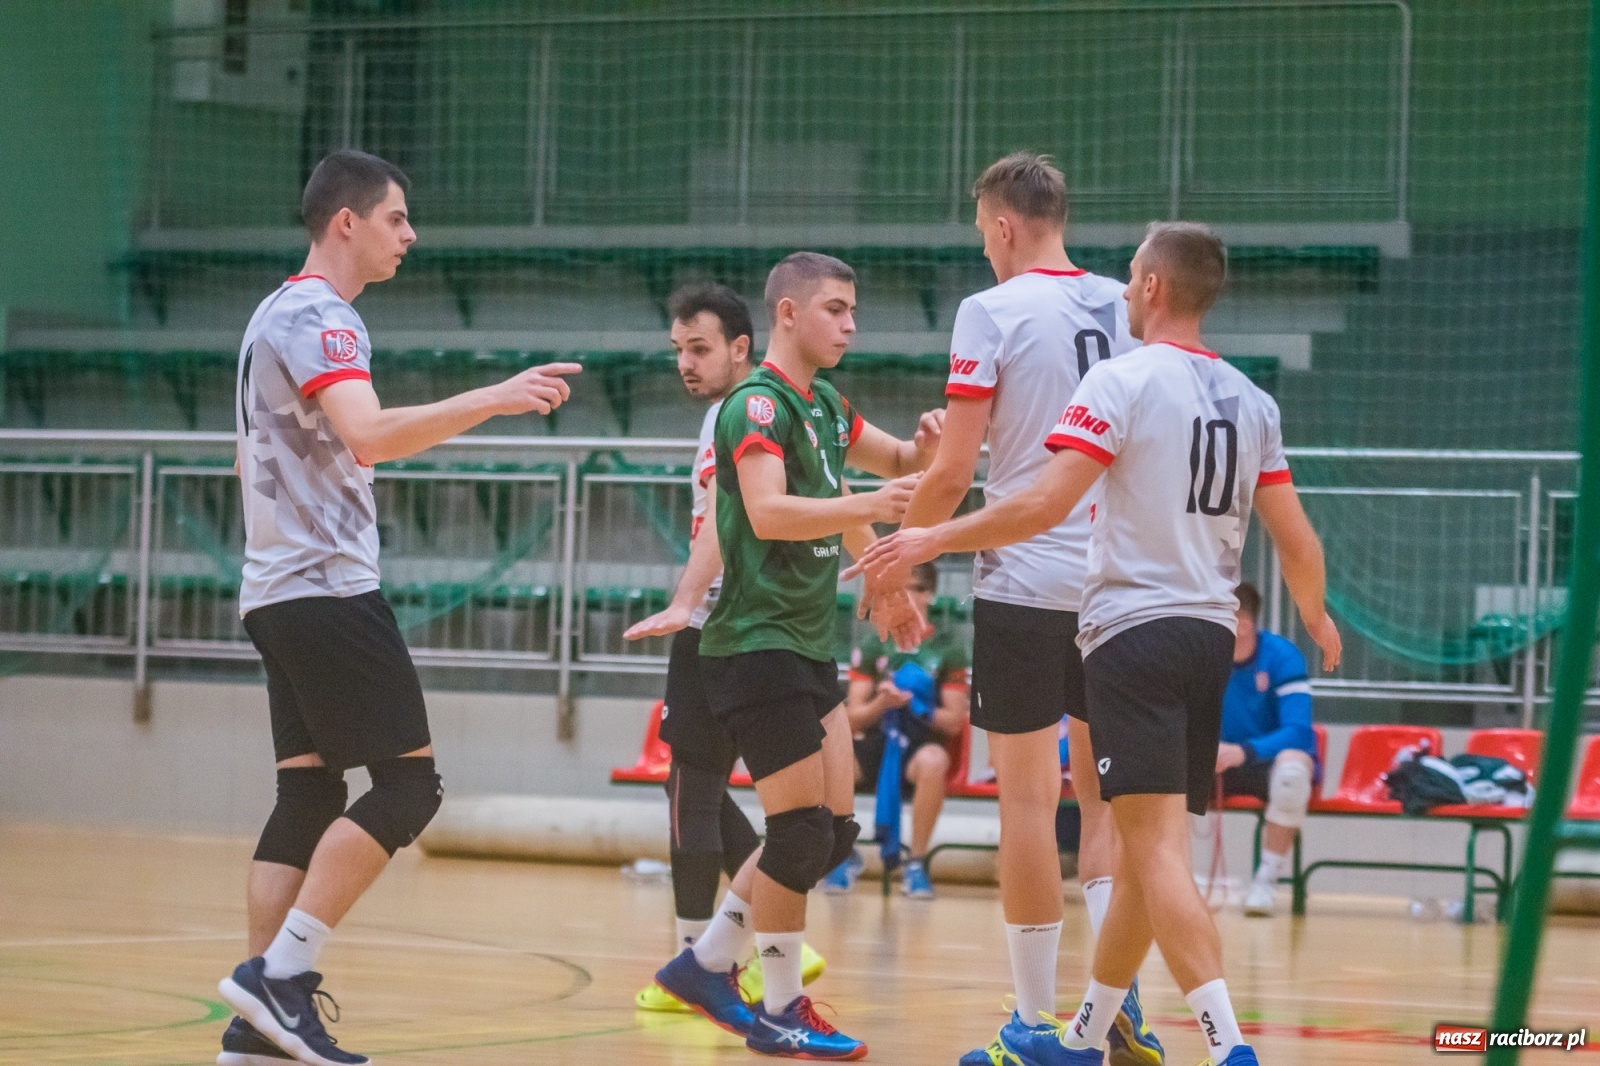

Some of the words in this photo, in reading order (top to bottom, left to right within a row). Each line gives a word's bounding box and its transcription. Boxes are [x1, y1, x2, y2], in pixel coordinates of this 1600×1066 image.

[1058, 405, 1111, 436] FAKO
[1186, 415, 1237, 516] 10
[1074, 1002, 1094, 1039] FILA
